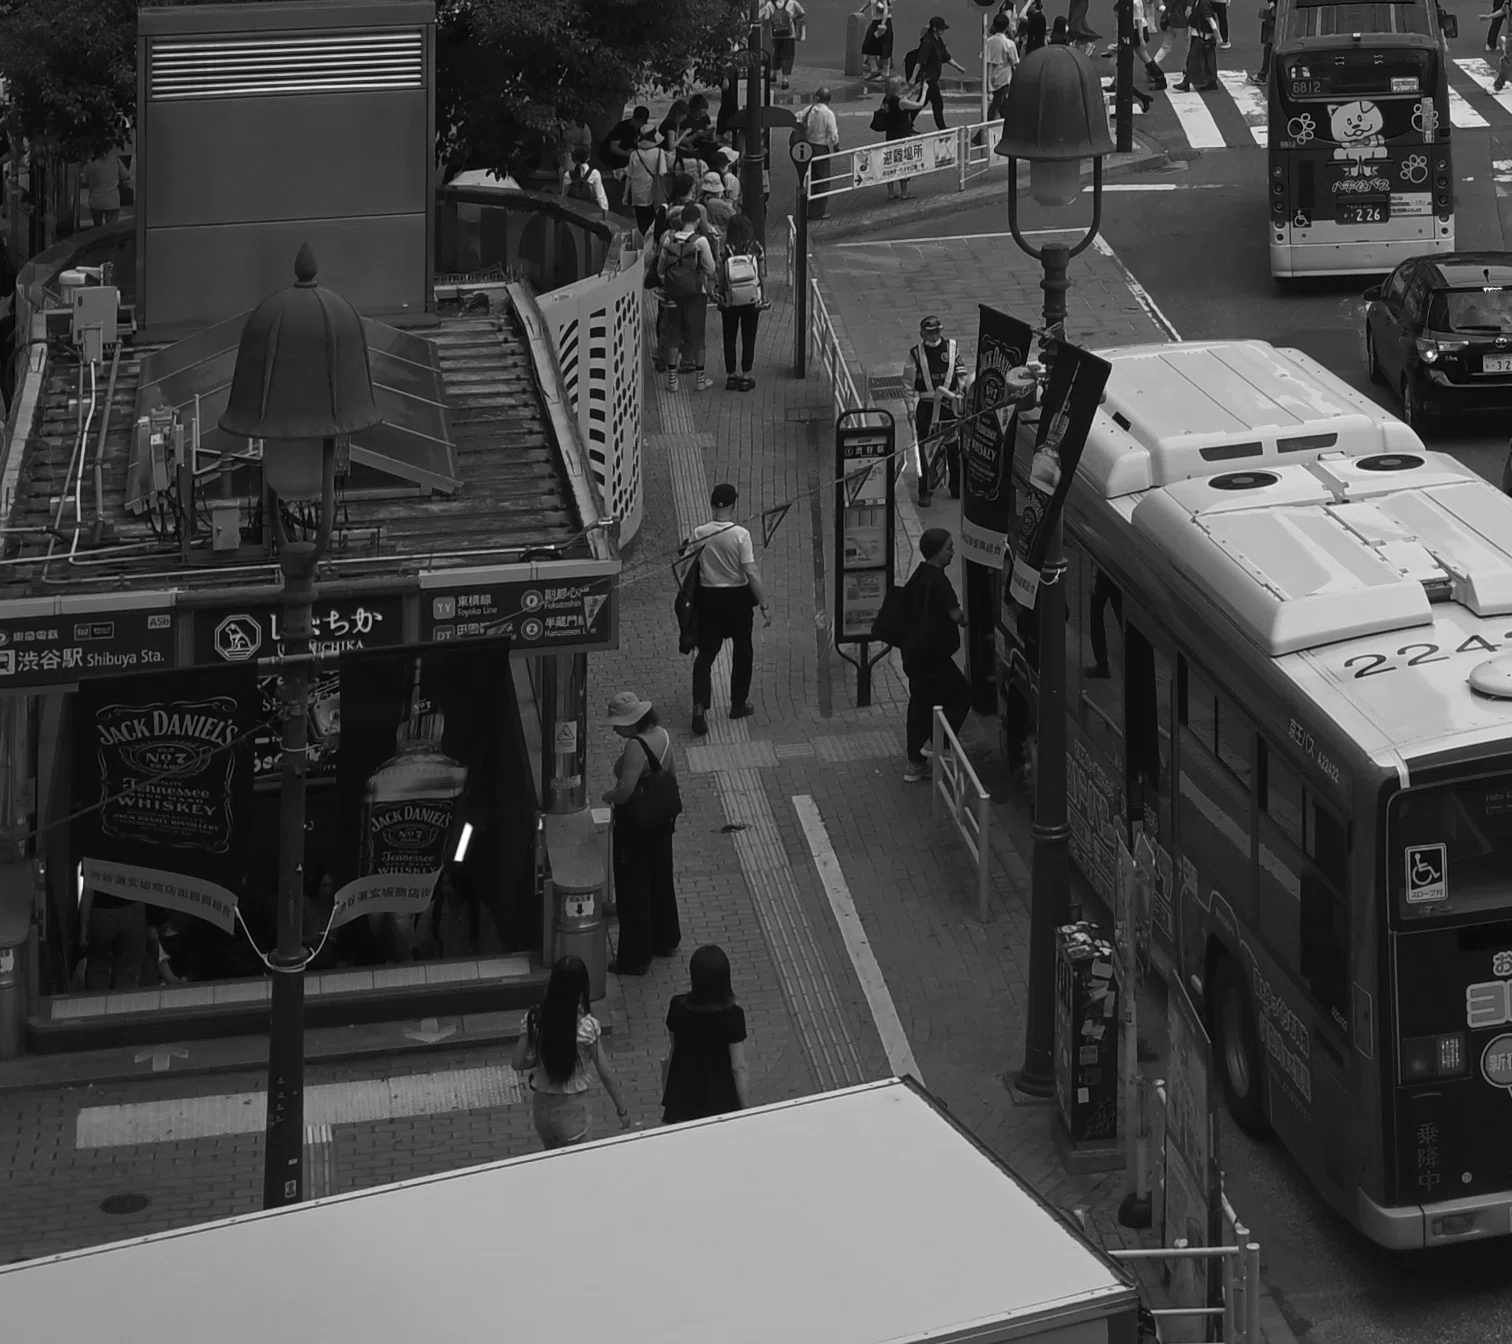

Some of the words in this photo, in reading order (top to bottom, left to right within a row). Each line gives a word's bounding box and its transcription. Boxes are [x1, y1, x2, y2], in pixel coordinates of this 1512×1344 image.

[1292, 79, 1321, 94] 6812
[437, 603, 452, 613] TY
[270, 608, 383, 641] しちか
[18, 648, 84, 672] 渋谷駅
[87, 653, 137, 668] Shibuya
[141, 650, 165, 665] Sta.
[97, 714, 152, 747] JACK
[153, 709, 240, 746] DANIEL'S
[1288, 719, 1317, 755] 京王バス
[118, 796, 217, 817] WHISKEY
[371, 808, 402, 833] JACK
[402, 805, 453, 829] DANIEL'S
[1417, 1122, 1441, 1192] 乗降中
